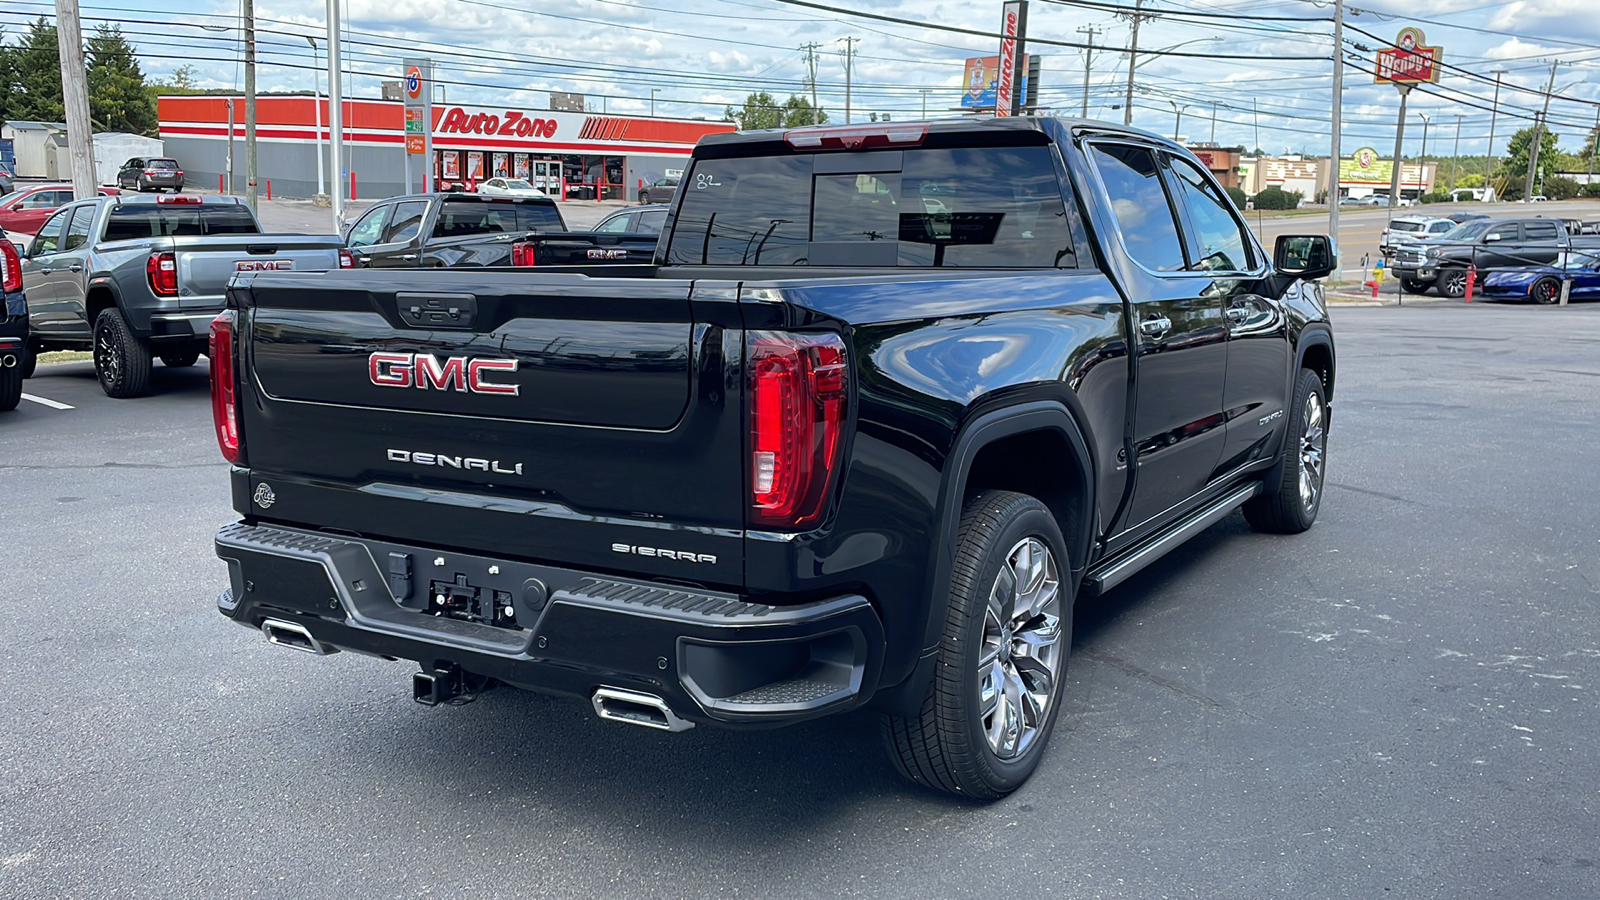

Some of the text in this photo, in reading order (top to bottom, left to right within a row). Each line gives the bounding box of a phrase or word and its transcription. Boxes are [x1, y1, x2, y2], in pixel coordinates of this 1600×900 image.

[1000, 12, 1017, 102] AutoZone
[406, 71, 419, 92] 76
[440, 107, 557, 138] AutoZone
[697, 173, 721, 189] 82
[587, 249, 627, 260] GMC
[237, 260, 292, 271] GMC
[369, 351, 521, 396] GMC
[387, 449, 523, 475] DENALI
[612, 543, 717, 564] SIERRA
